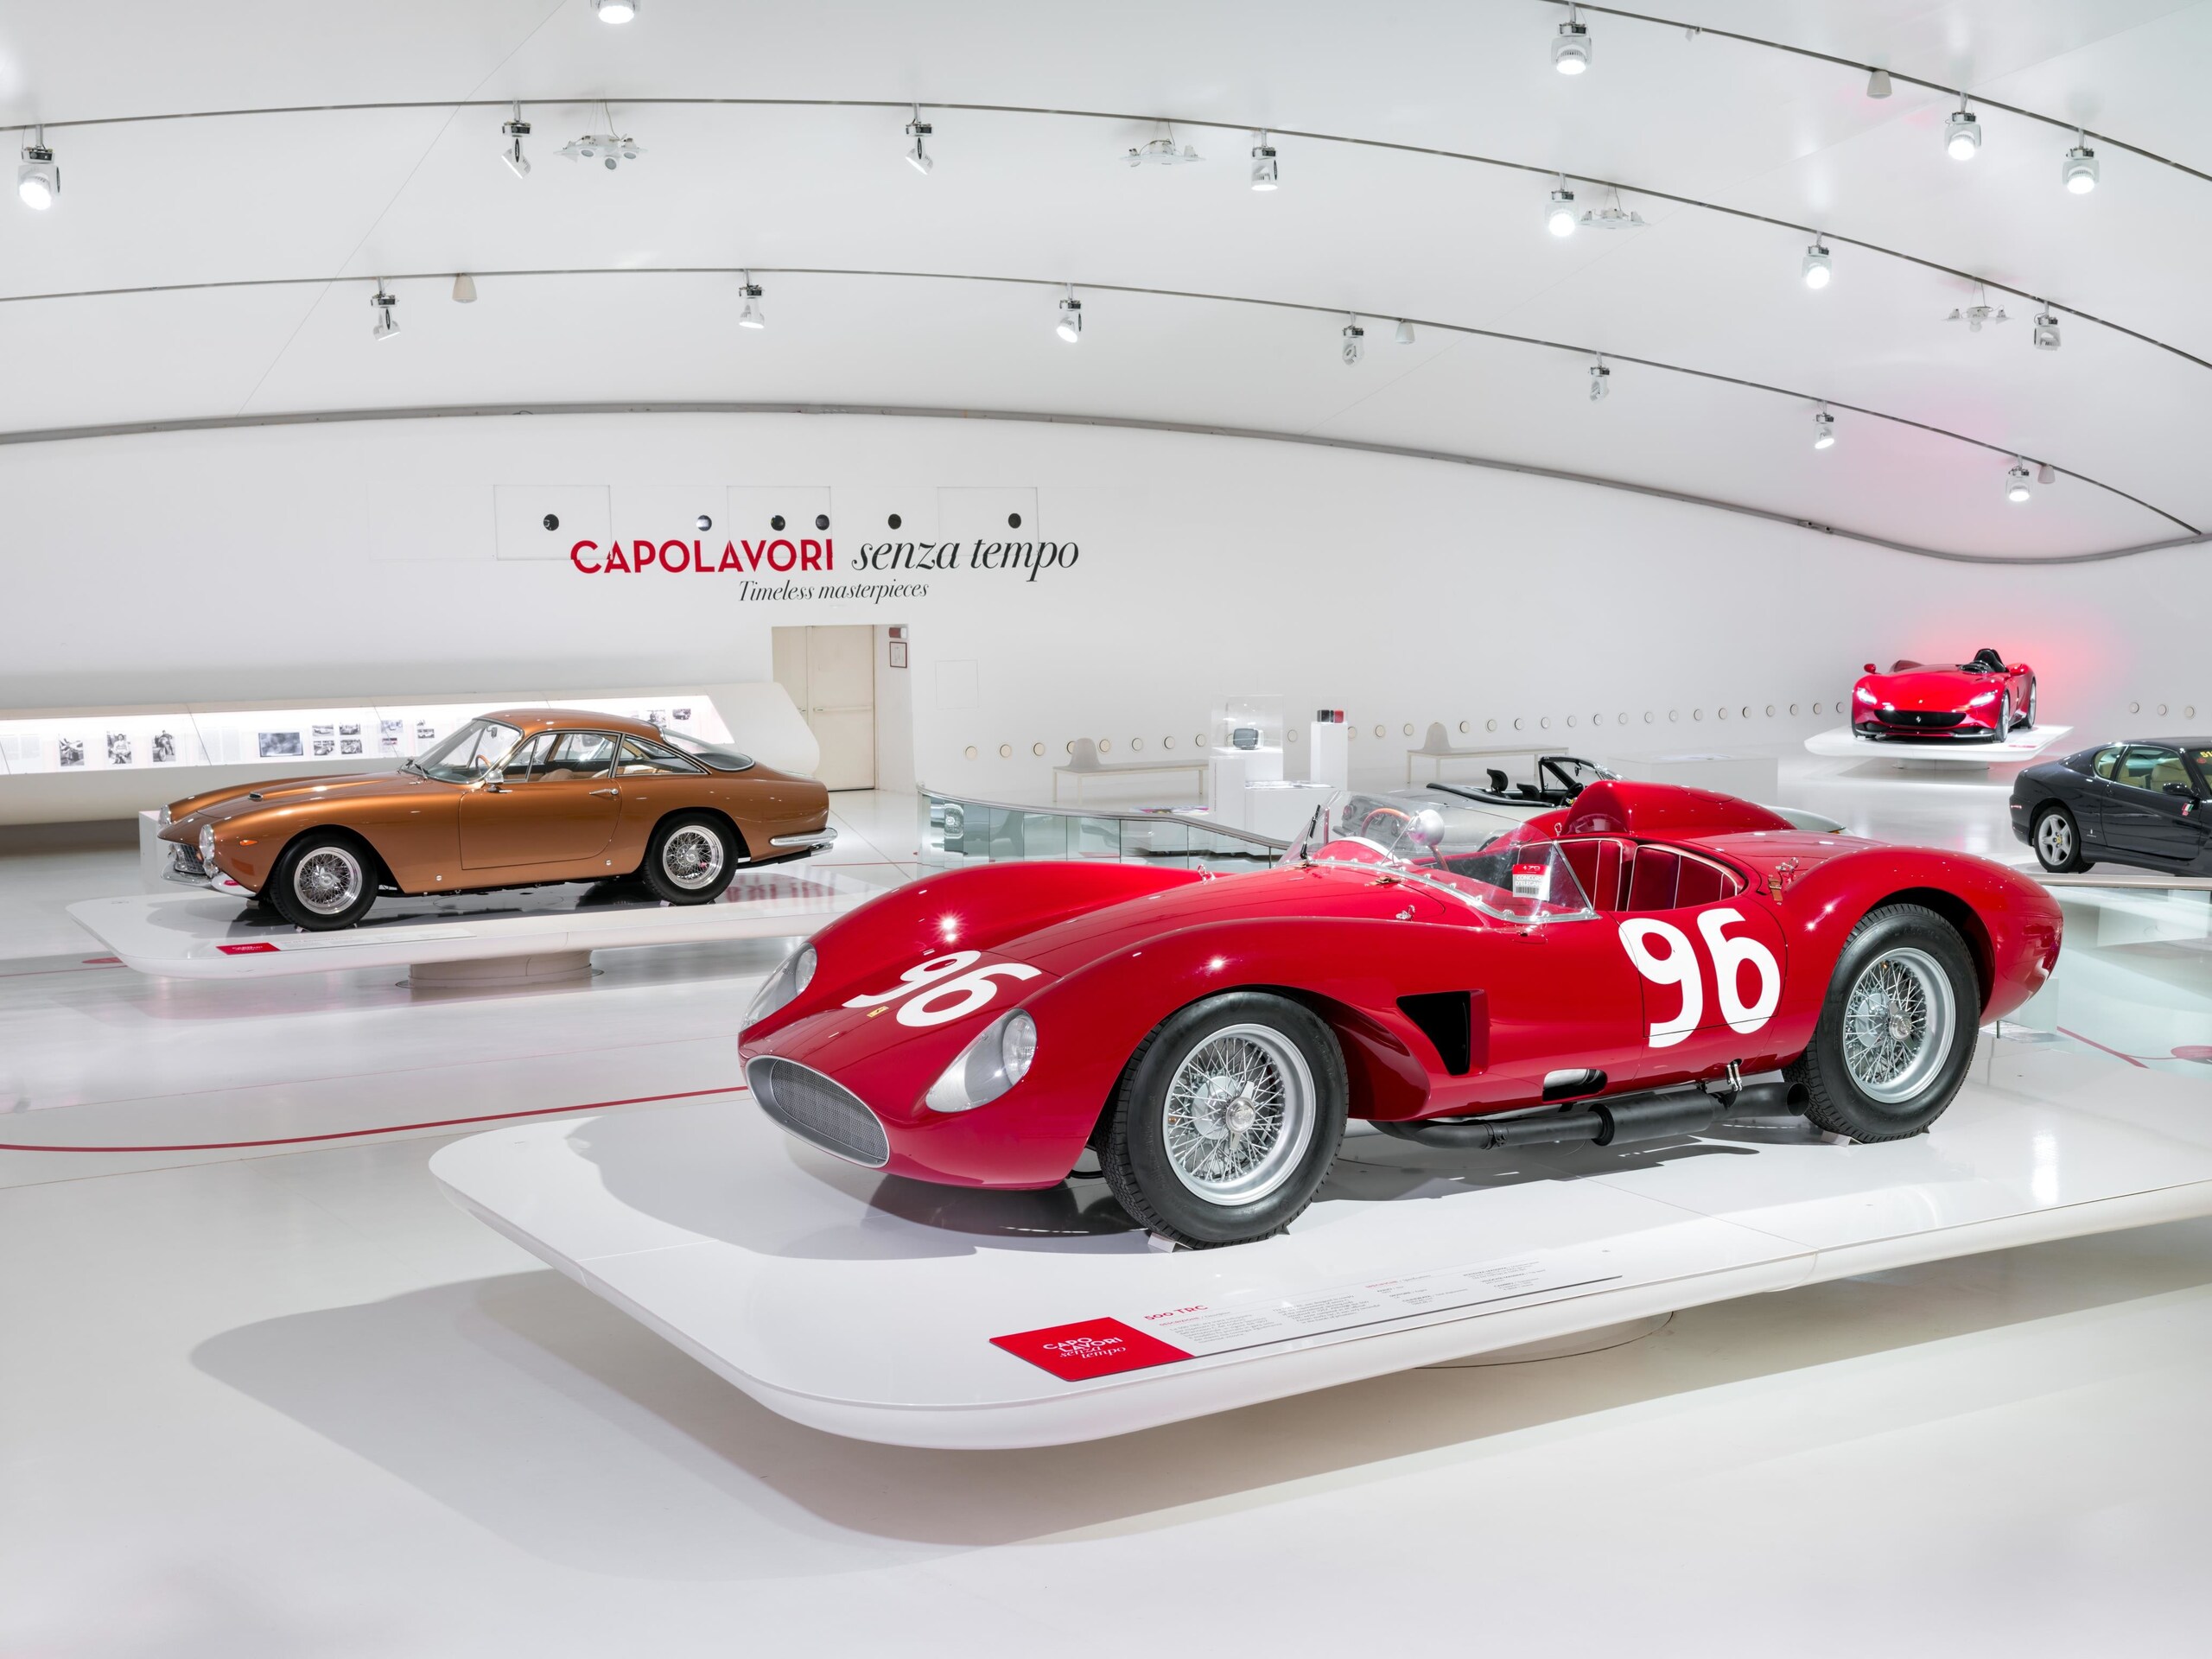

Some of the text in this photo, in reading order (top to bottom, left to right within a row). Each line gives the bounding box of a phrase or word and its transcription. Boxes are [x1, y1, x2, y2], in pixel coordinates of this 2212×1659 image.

[570, 537, 1080, 582] CAPOLAVORI senza tempo
[738, 578, 929, 605] Timeless masterpieces
[1618, 907, 1781, 1048] 96
[842, 950, 1042, 1027] 96
[1144, 1305, 1209, 1320] 500 TRC
[1042, 1337, 1093, 1350] CAPO
[1058, 1337, 1123, 1353] LAVORI
[1059, 1345, 1102, 1358] senza
[1081, 1345, 1127, 1359] tempo
